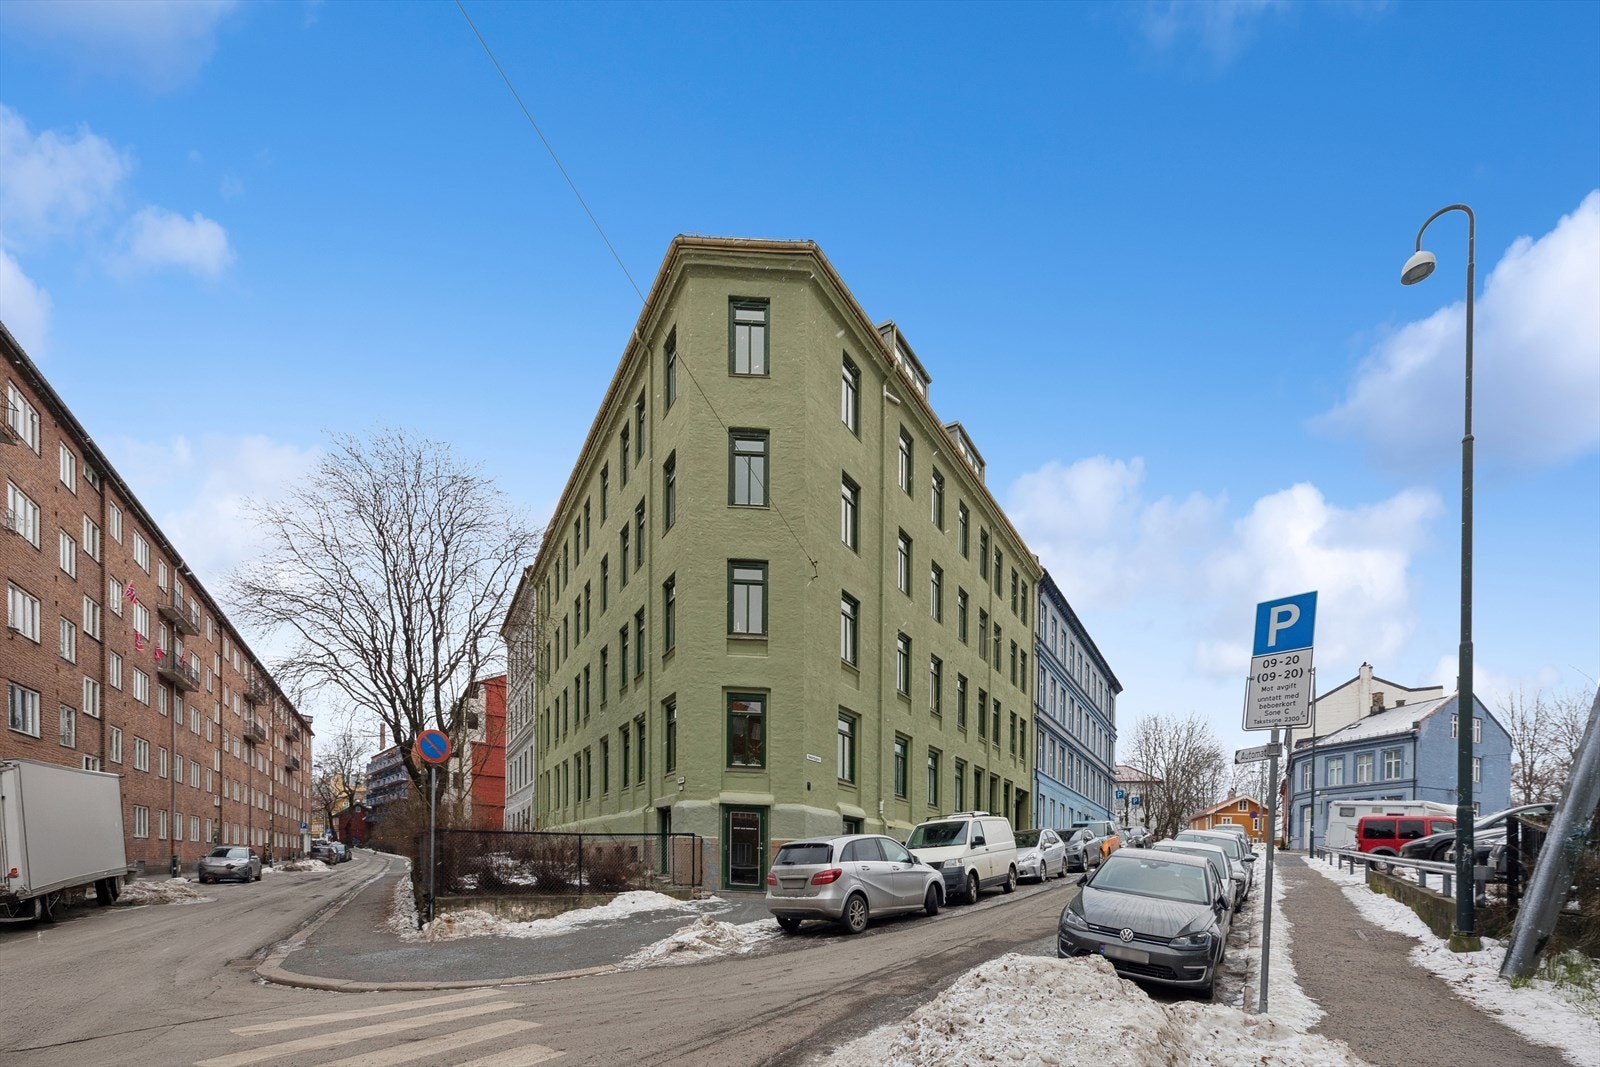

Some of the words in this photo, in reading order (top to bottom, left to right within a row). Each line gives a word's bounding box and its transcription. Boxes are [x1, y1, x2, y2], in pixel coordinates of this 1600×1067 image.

[1267, 603, 1300, 647] P
[1262, 655, 1300, 669] 09-20
[1257, 667, 1304, 683] (09-20)
[1276, 683, 1297, 691] avgift
[1257, 695, 1282, 703] unntatt
[1284, 692, 1300, 700] med
[1258, 701, 1296, 710] beboerkort
